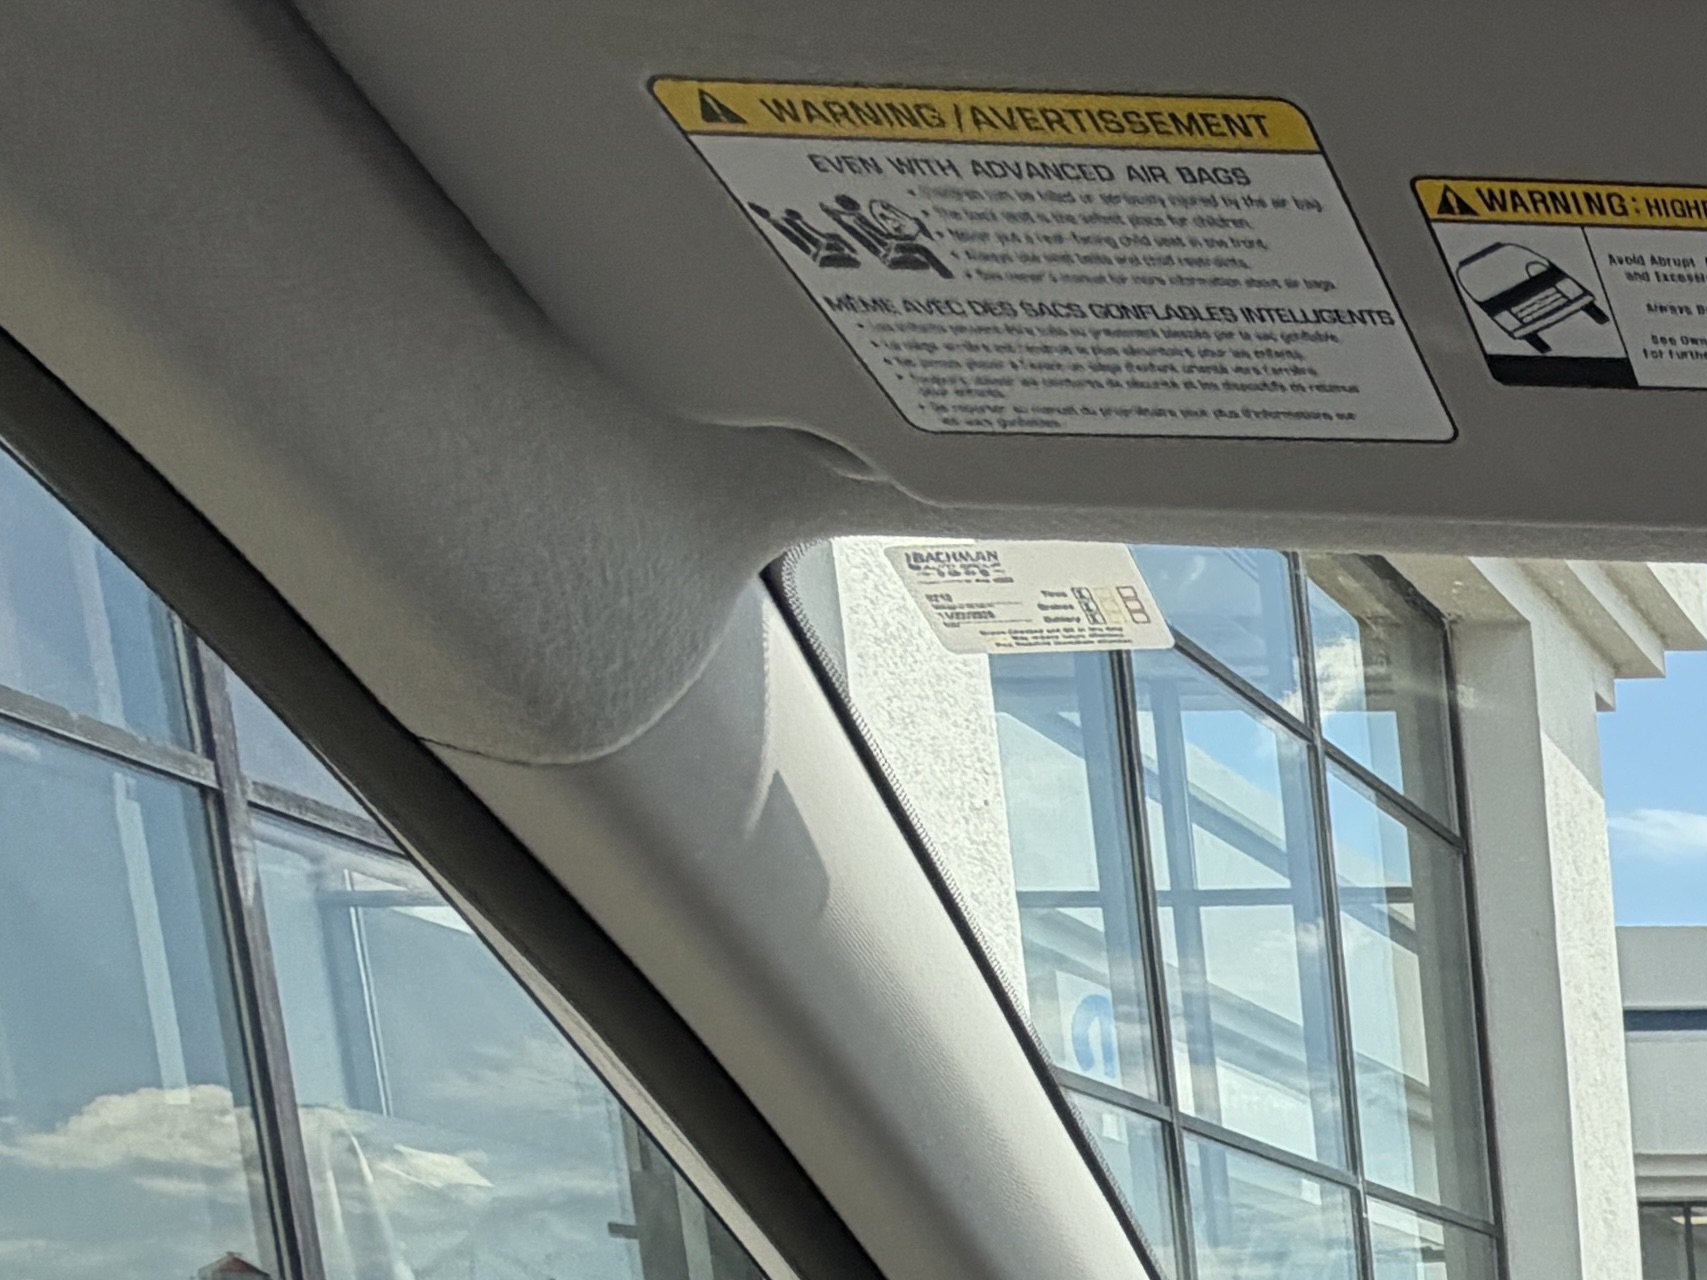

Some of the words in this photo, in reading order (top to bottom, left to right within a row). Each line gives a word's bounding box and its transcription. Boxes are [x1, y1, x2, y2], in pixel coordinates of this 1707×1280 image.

[808, 153, 883, 175] EVEN
[887, 155, 963, 179] WITH
[971, 158, 1115, 182] ADVANCED
[1127, 164, 1169, 184] AIR
[1176, 165, 1252, 186] BAGS
[1607, 253, 1645, 267] Avoid
[823, 294, 898, 314] MÊME
[902, 298, 967, 316] AVEC
[967, 299, 1018, 318] DES
[1020, 300, 1087, 319] SACS
[1242, 306, 1396, 327] INTELLIGENTS
